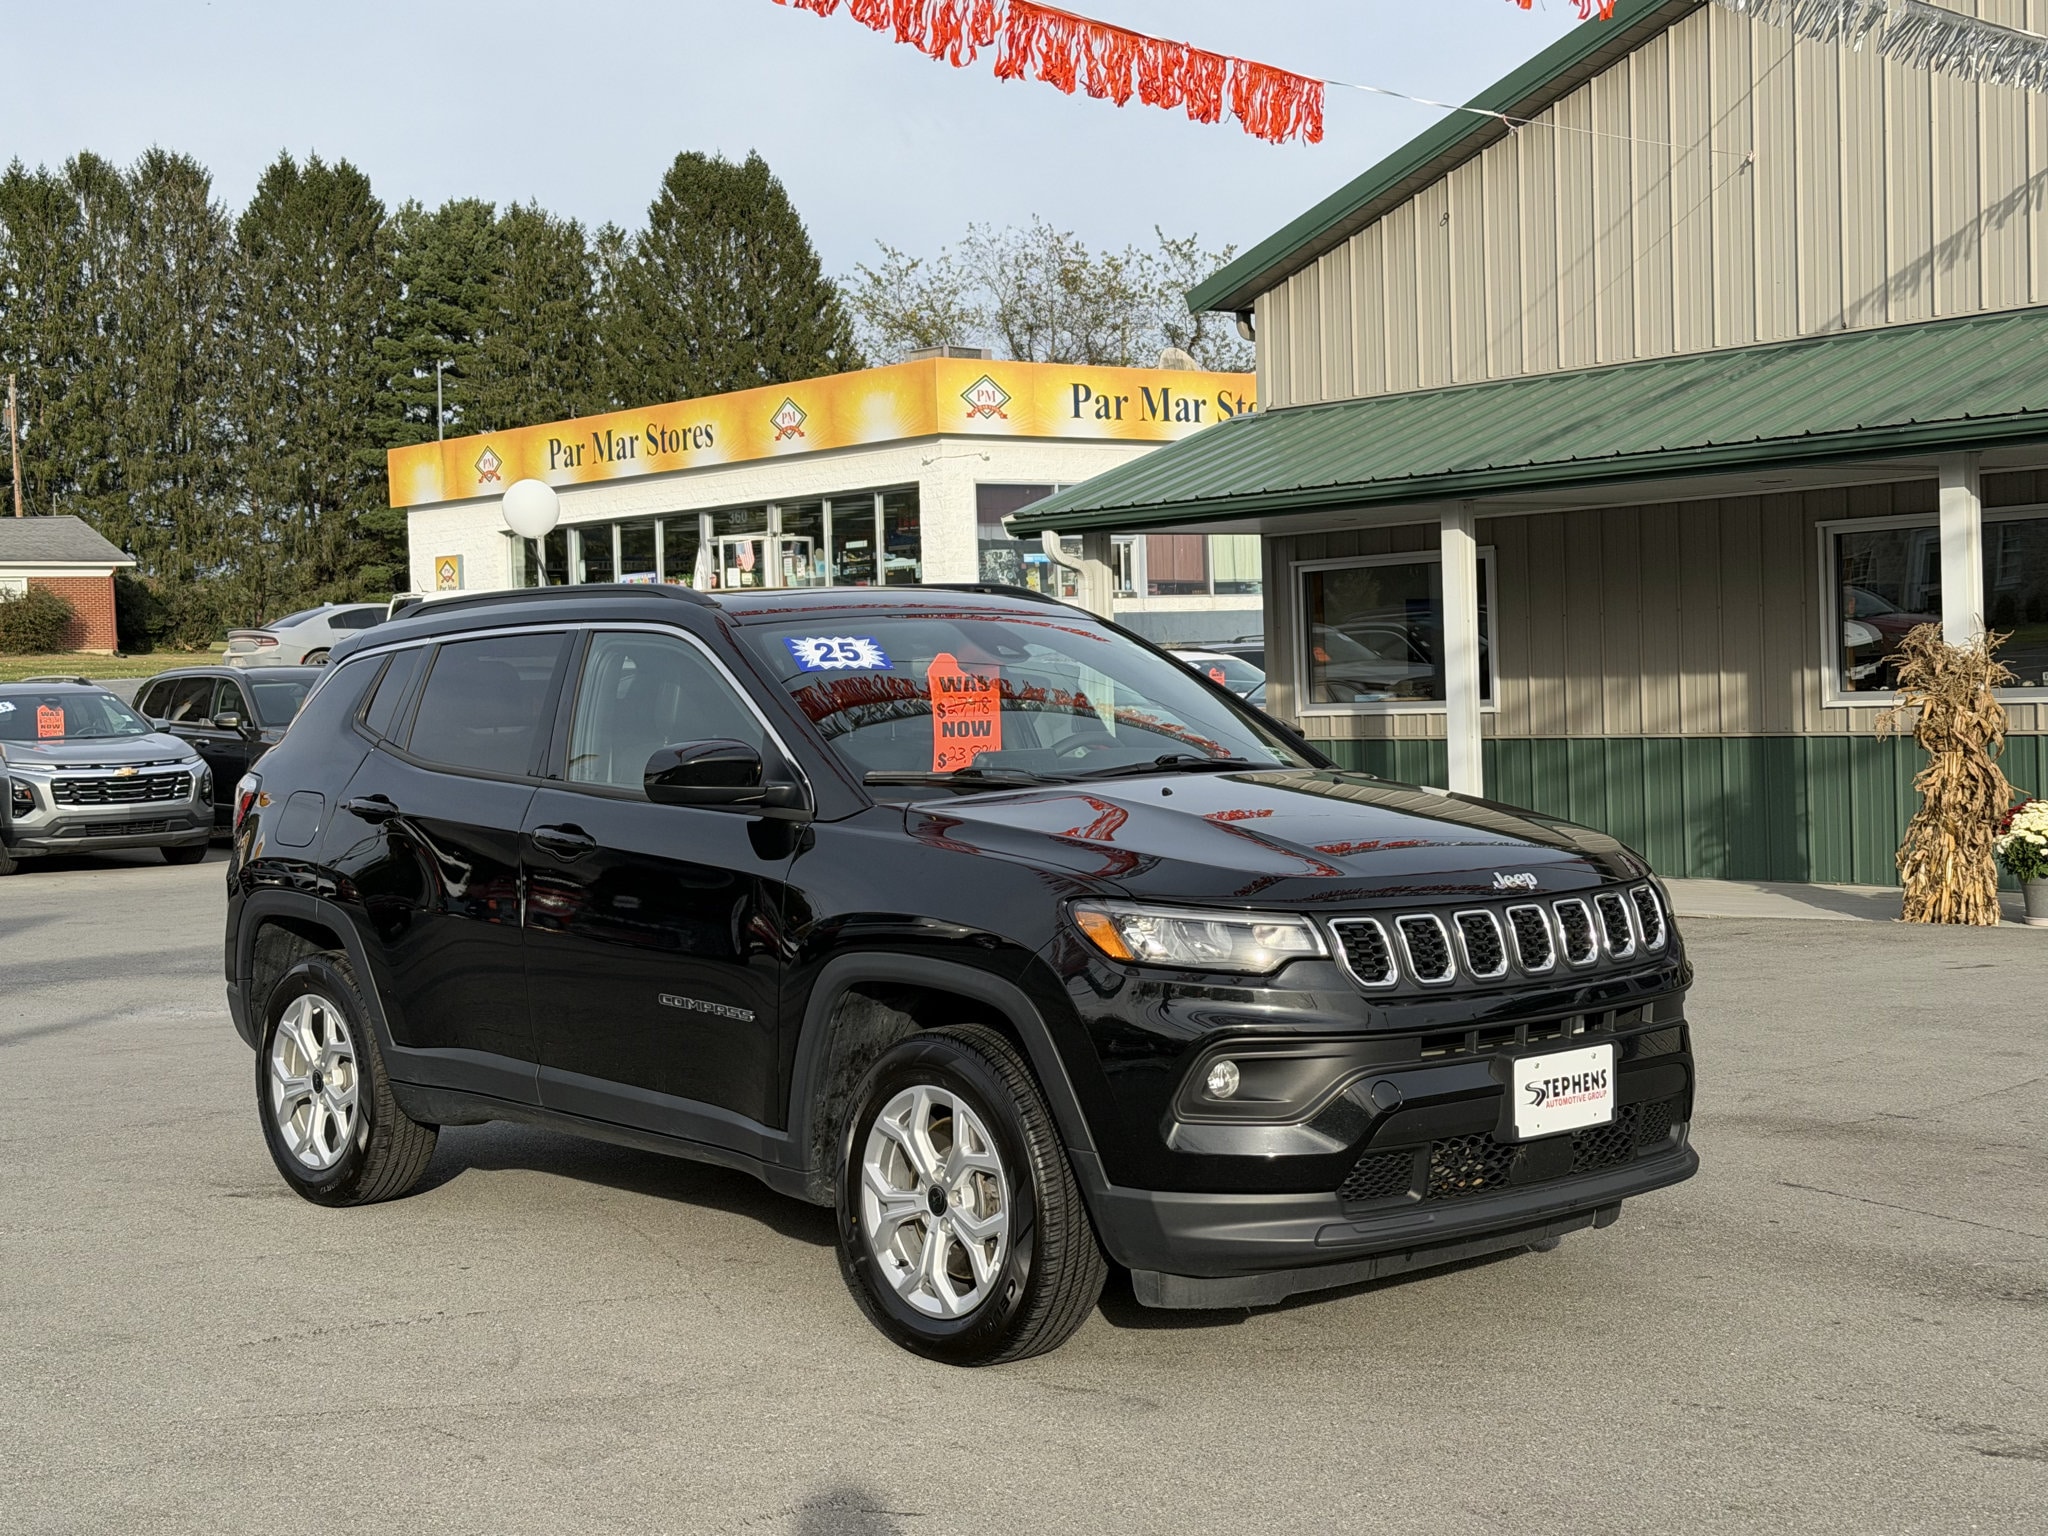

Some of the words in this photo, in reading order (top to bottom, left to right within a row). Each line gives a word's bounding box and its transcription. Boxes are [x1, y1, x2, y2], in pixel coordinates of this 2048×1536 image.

[976, 389, 996, 403] PM
[1070, 382, 1129, 421] Par
[1138, 386, 1207, 423] Mar
[781, 411, 796, 425] PM
[548, 438, 585, 470] Par
[591, 429, 639, 464] Mar
[646, 423, 714, 457] Stores
[483, 458, 495, 470] PM
[728, 511, 748, 524] 360
[813, 641, 862, 663] 25
[938, 675, 991, 693] WAS
[942, 720, 992, 738] NOW
[1492, 871, 1538, 889] Jeep
[658, 993, 756, 1023] COMPASS
[1524, 1069, 1607, 1107] STEPHENS
[1545, 1094, 1587, 1109] AUTOMOTIVE
[1587, 1089, 1608, 1101] GROUP
